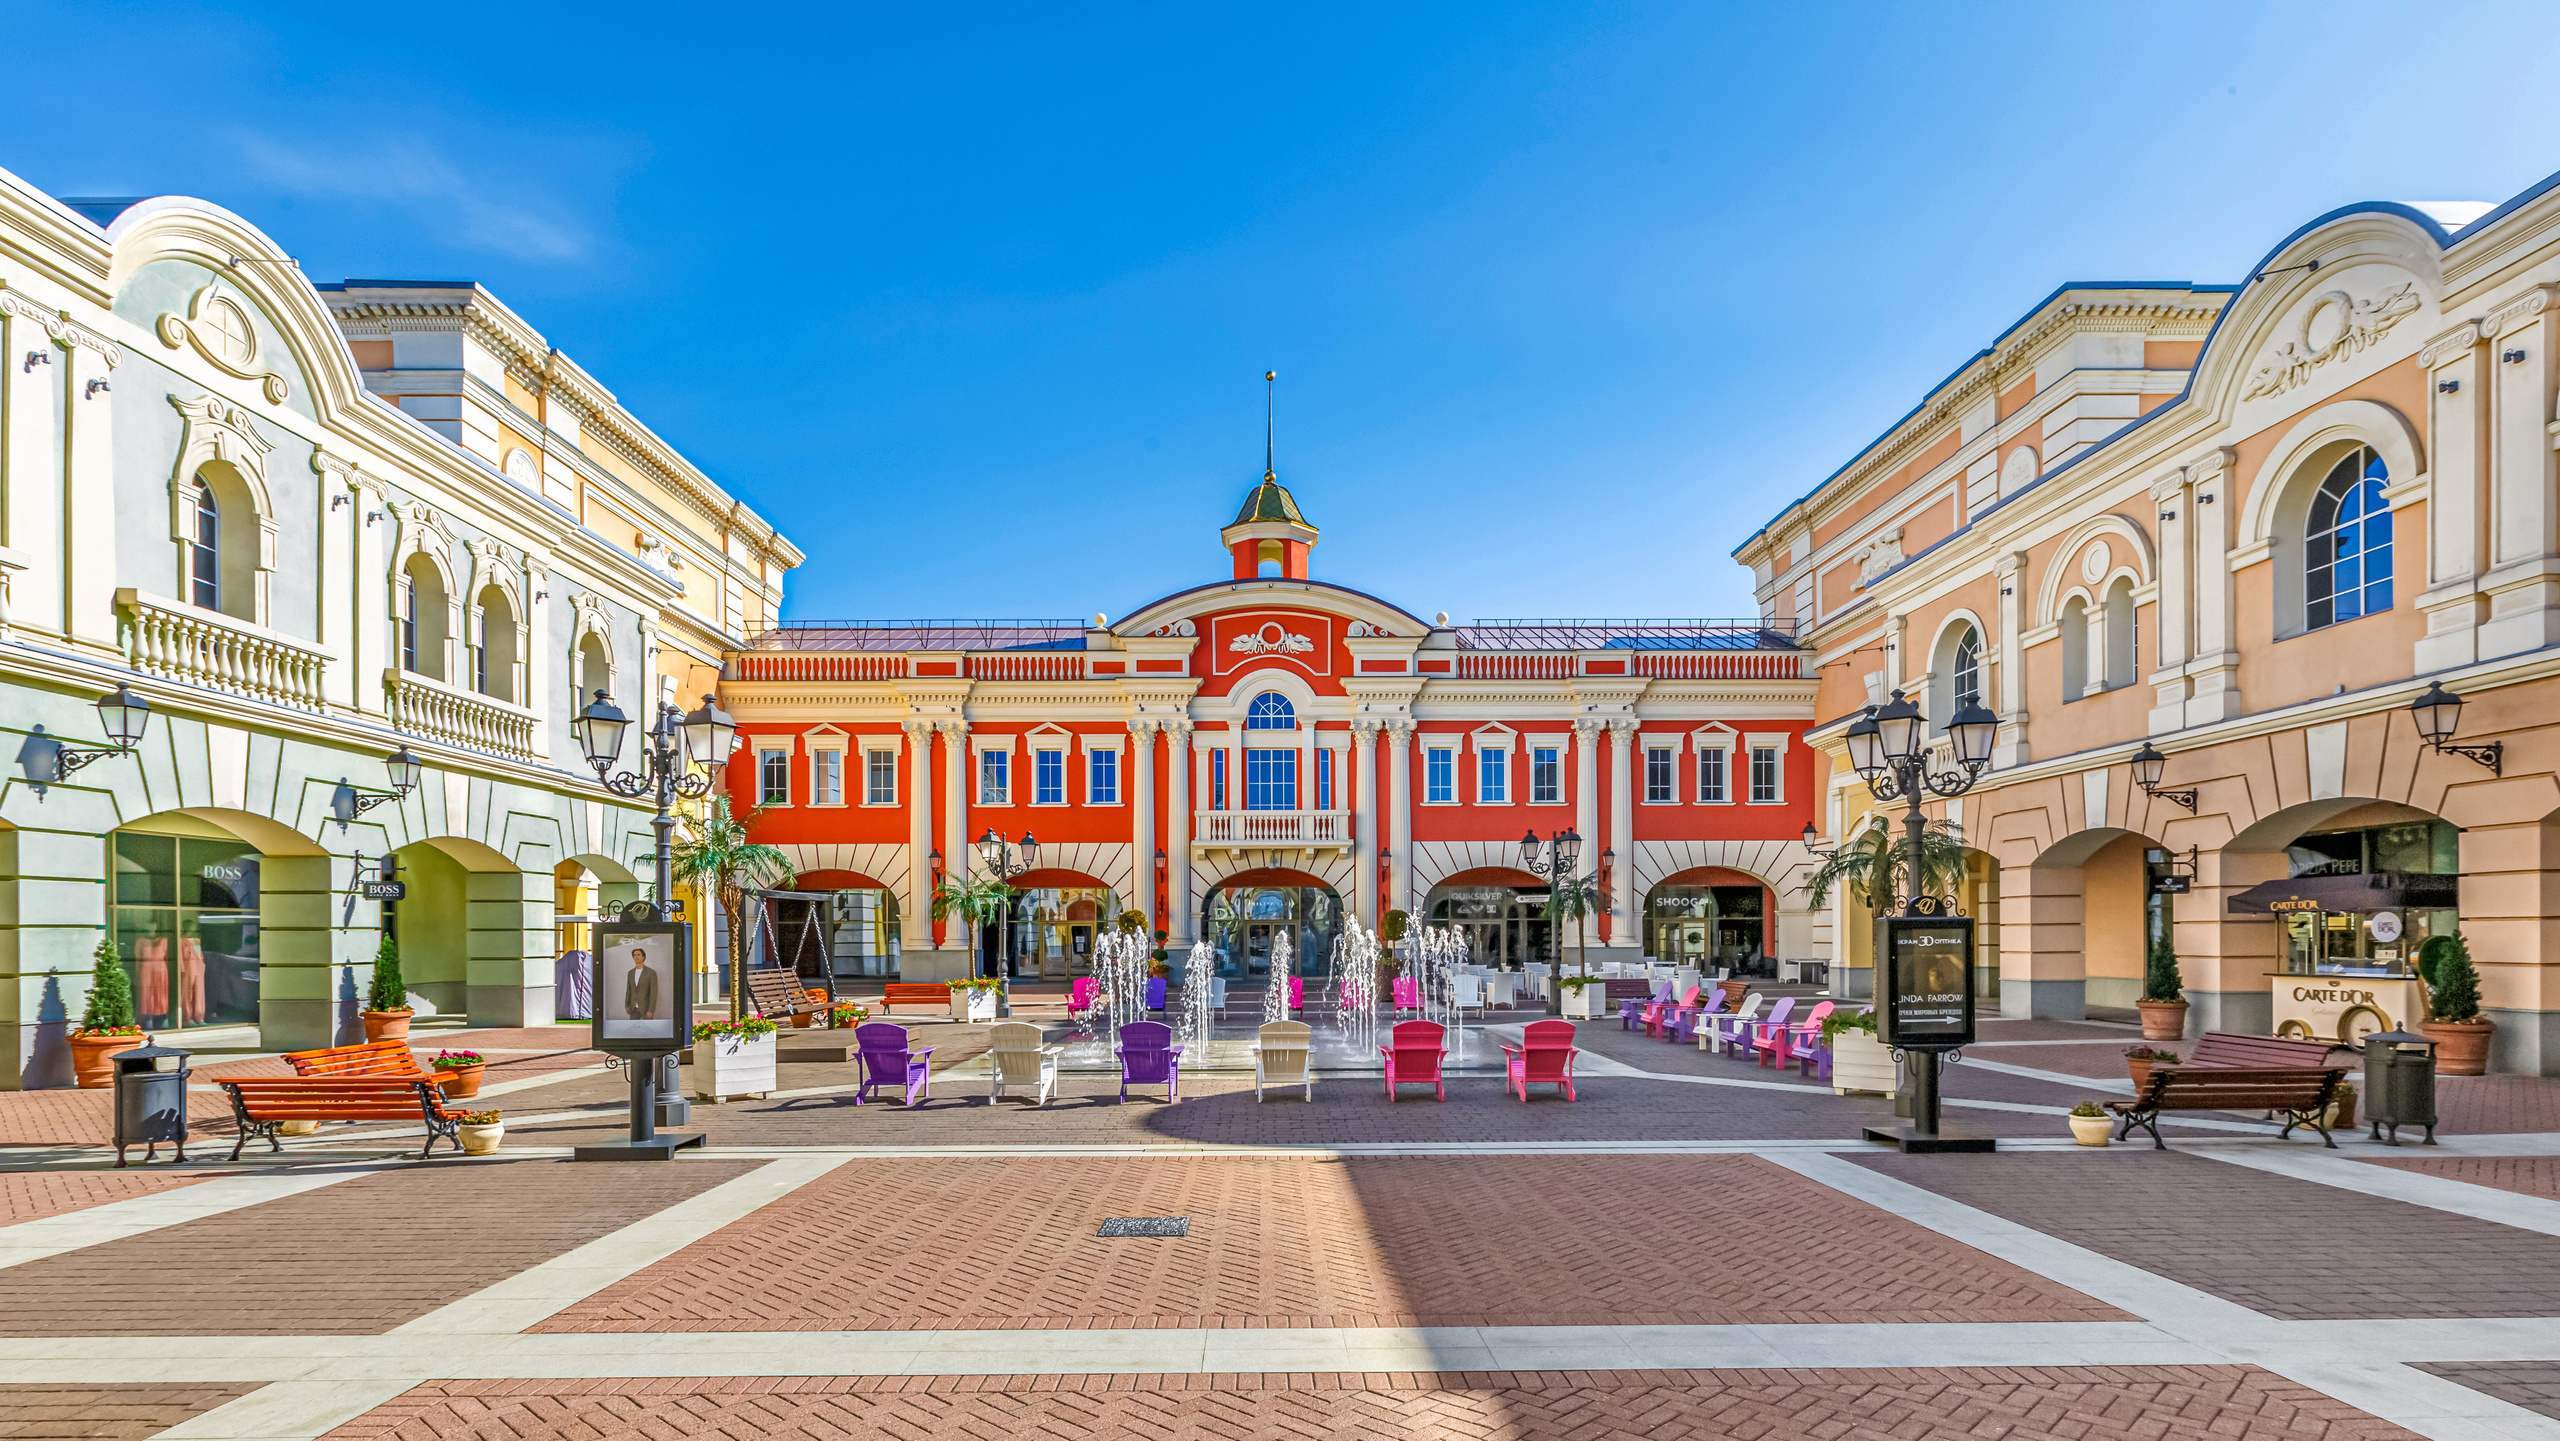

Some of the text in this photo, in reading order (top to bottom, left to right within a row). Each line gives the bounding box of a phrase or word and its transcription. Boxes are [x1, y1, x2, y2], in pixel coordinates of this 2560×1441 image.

[2331, 859, 2360, 874] PEPE
[203, 865, 242, 880] BOSS
[369, 885, 400, 894] BOSS
[1451, 892, 1503, 901] QUIKSILVER
[2270, 900, 2296, 911] CARTE
[1927, 994, 1963, 1003] FARROW
[2293, 986, 2338, 1004] CARTE
